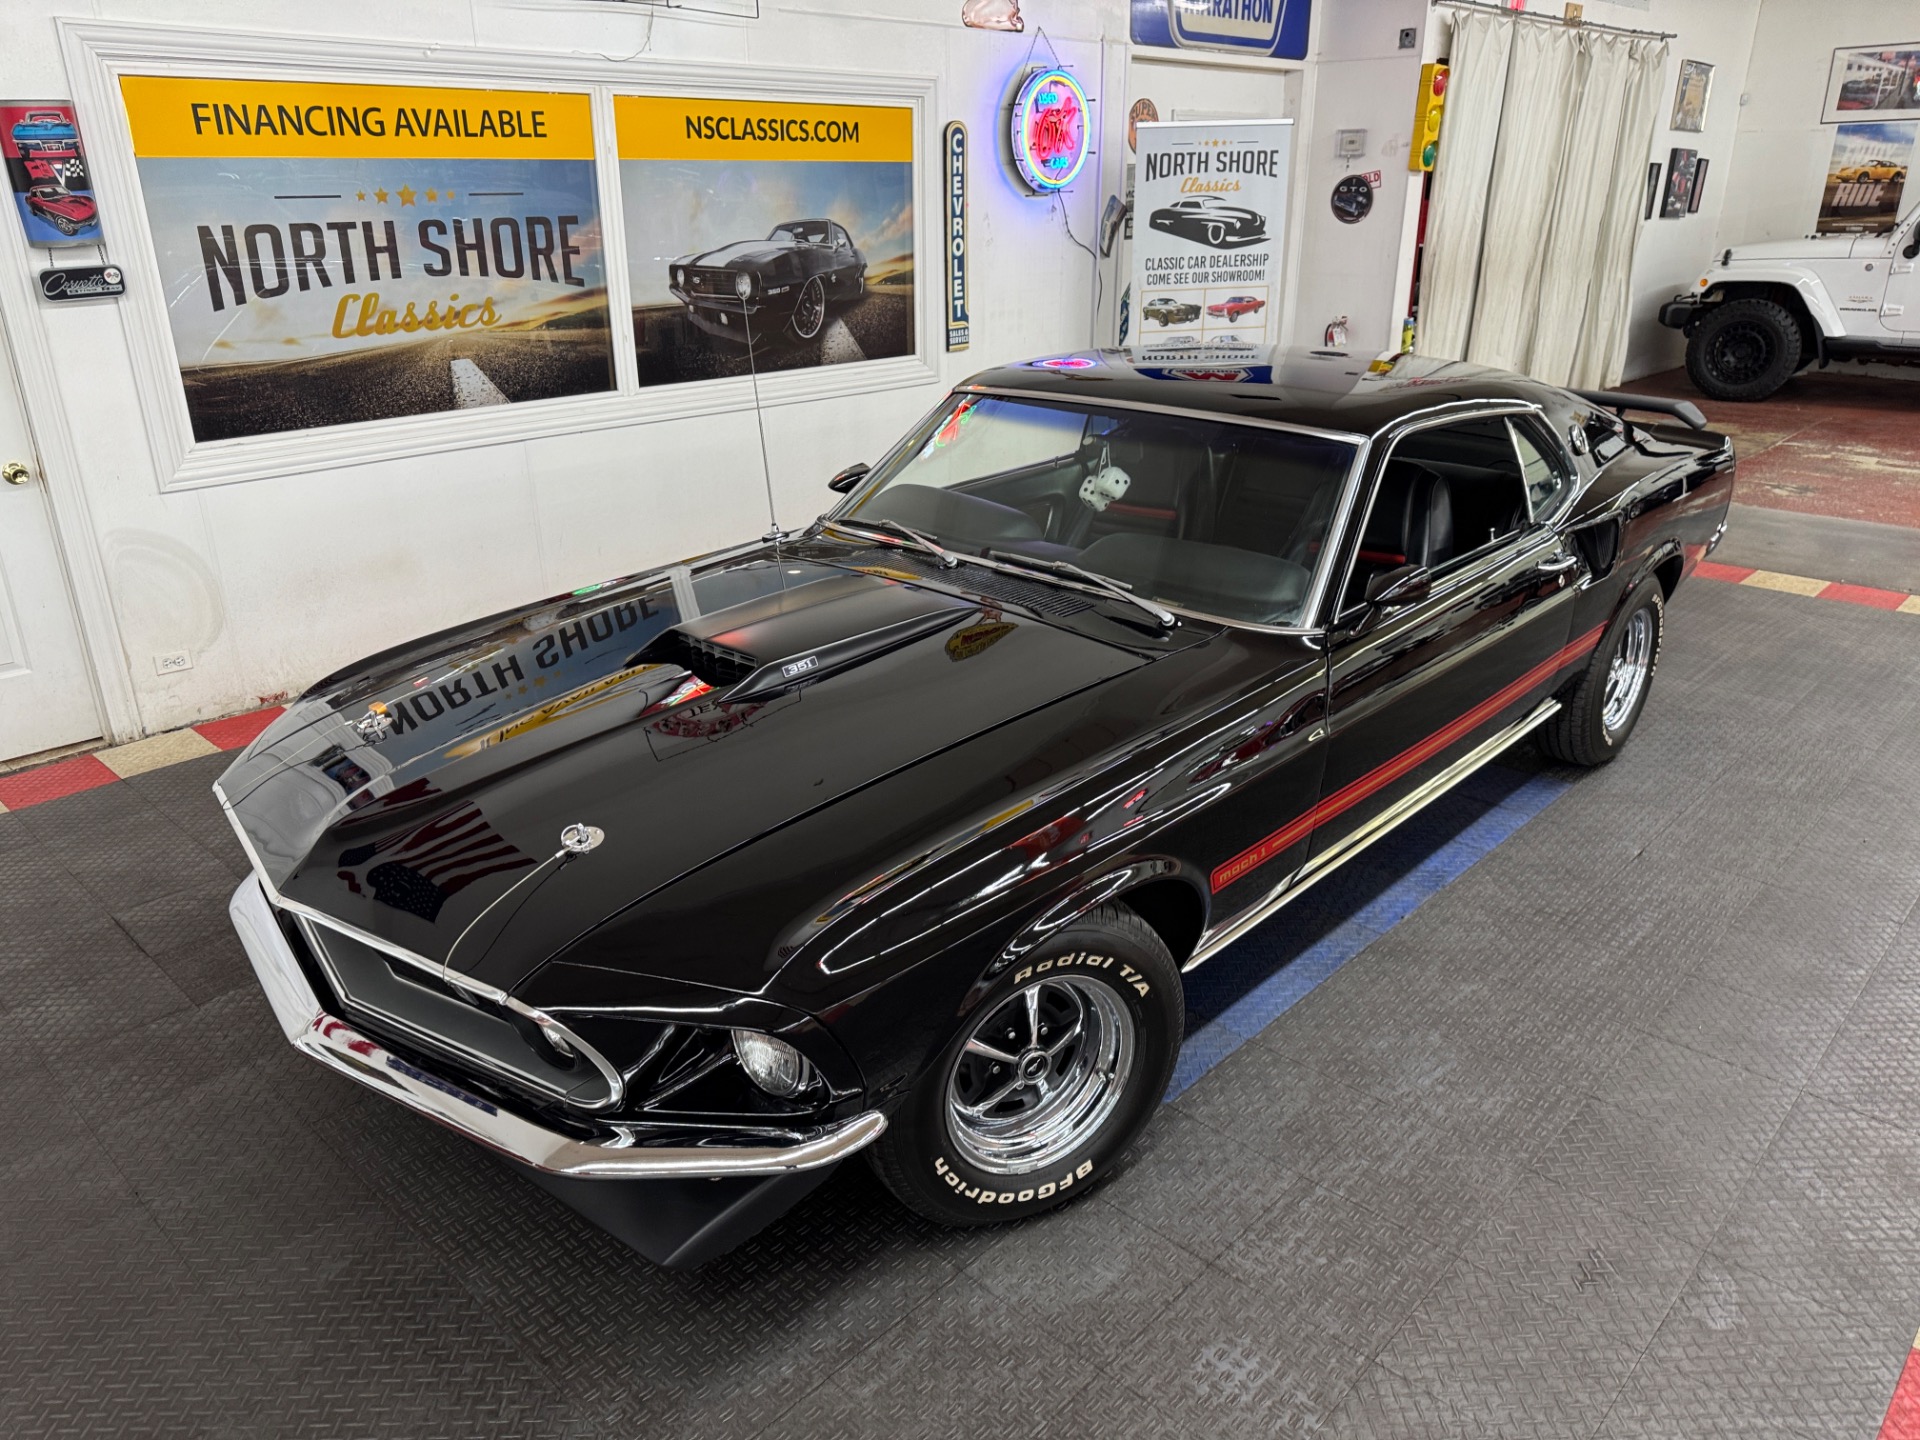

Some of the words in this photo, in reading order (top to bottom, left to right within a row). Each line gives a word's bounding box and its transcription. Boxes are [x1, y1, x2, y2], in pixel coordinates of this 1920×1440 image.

[1184, 0, 1273, 23] RATHON
[190, 103, 385, 137] FINANCING
[394, 107, 548, 138] AVAILABLE
[685, 115, 860, 143] NSCLASSICS.COM
[1145, 151, 1209, 182] NORTH
[1216, 150, 1279, 178] SHORE
[1362, 172, 1380, 183] OLD
[1180, 177, 1242, 193] Classics
[1339, 185, 1368, 193] GTO
[1831, 182, 1884, 207] RIDE
[952, 133, 964, 318] CHEVROLET
[197, 220, 401, 312] NORTH
[419, 215, 585, 288] SHORE
[1145, 256, 1185, 271] CLASSIC
[1187, 255, 1207, 270] CAR
[1209, 253, 1270, 268] DEALERSHIP
[44, 273, 107, 295] Corvette
[1146, 272, 1171, 285] COME
[1174, 272, 1189, 284] SEE
[1191, 270, 1209, 283] OUR
[1211, 269, 1265, 282] SHOWROOM!
[331, 292, 503, 339] Classics
[788, 660, 813, 676] 351
[1219, 853, 1257, 883] mach
[1260, 847, 1266, 857] 1
[1014, 951, 1114, 984] Radial
[1119, 964, 1151, 998] T/A
[934, 1156, 1094, 1205] BFGoodrich
